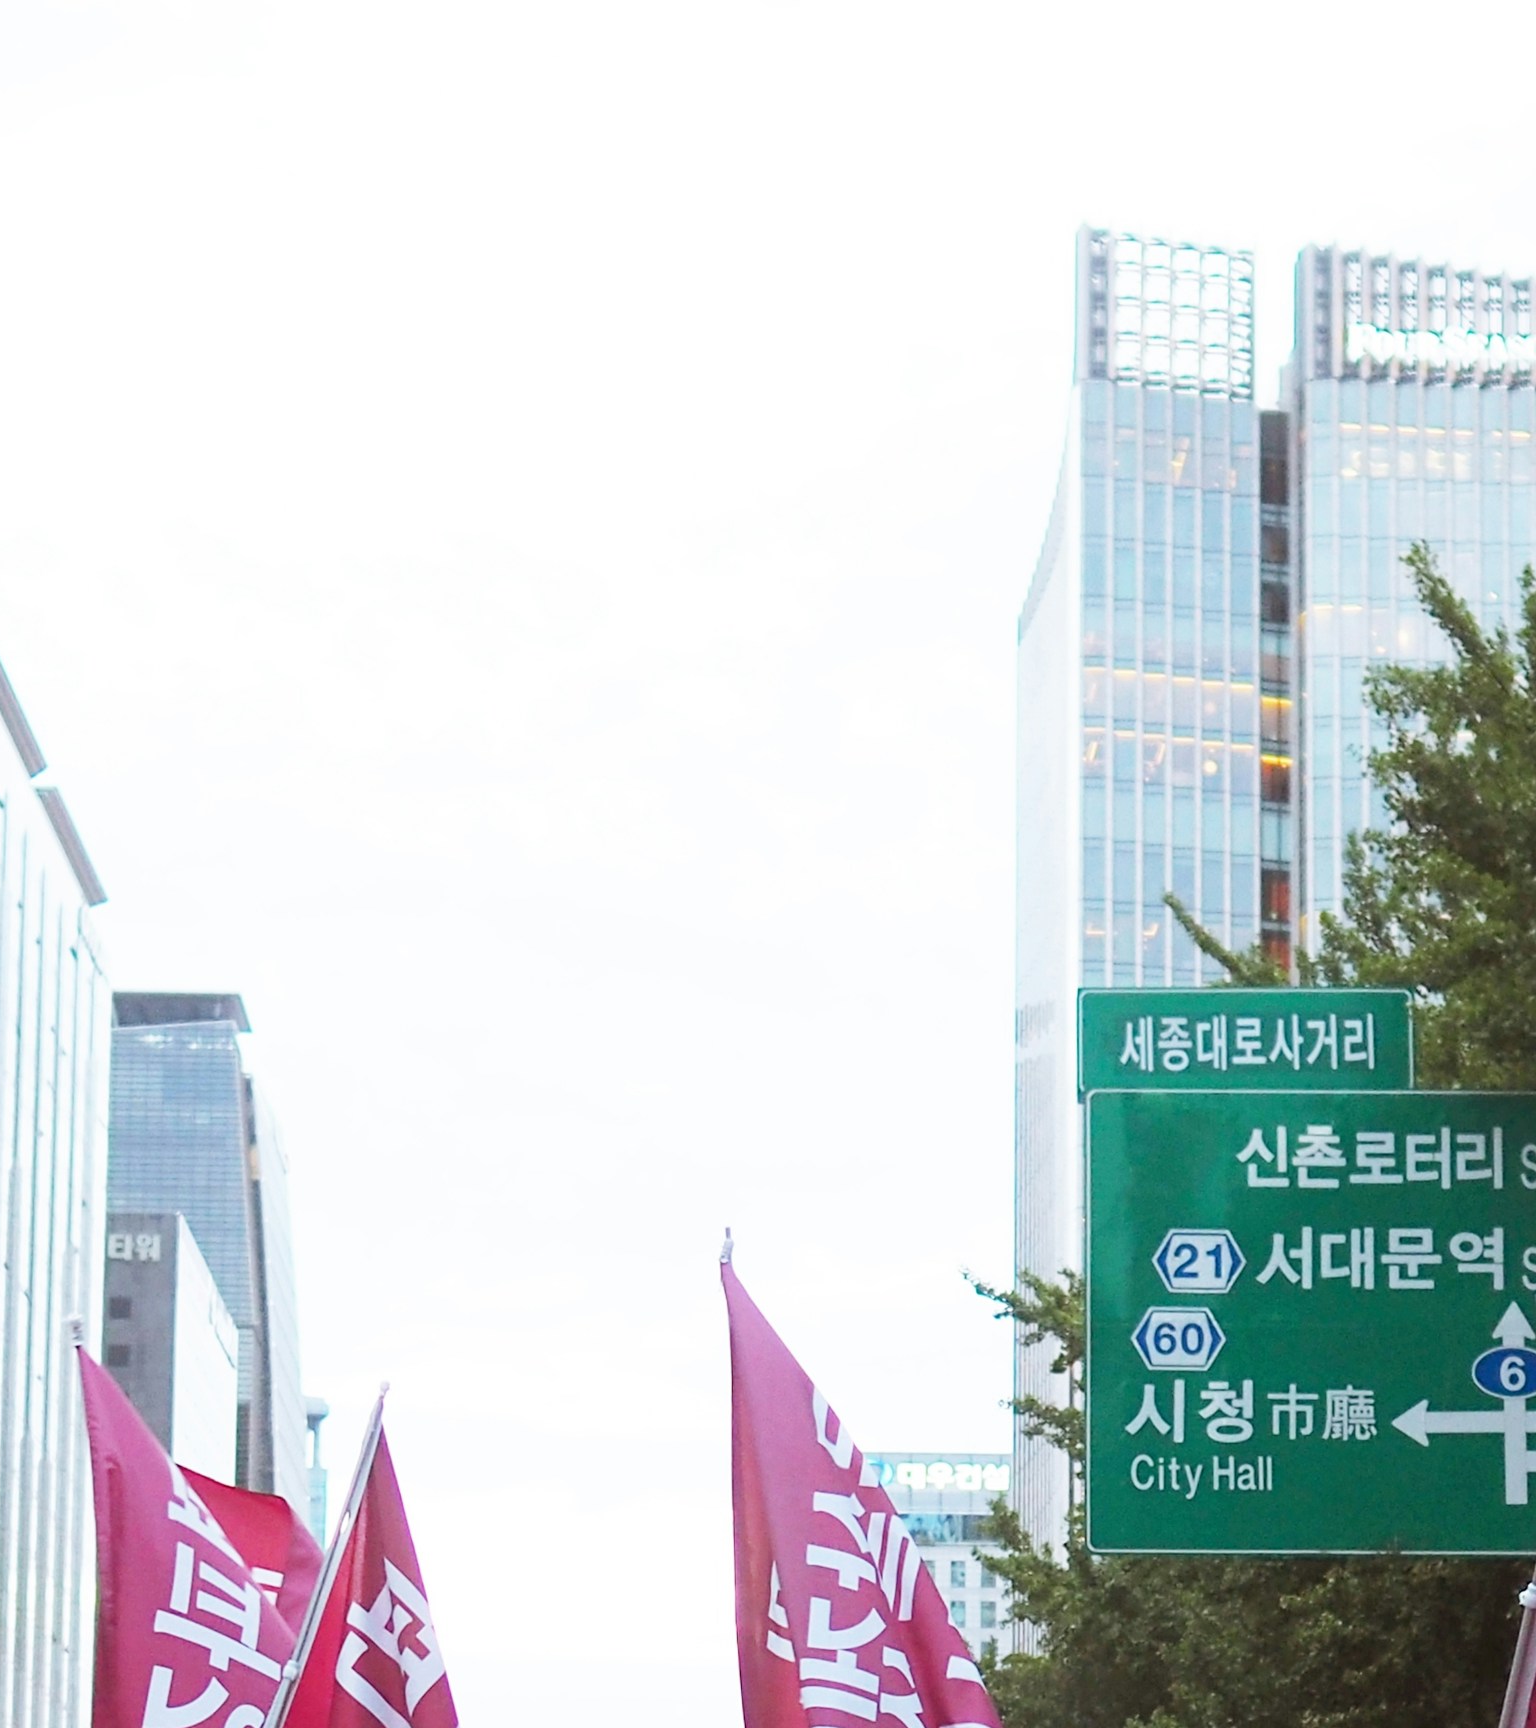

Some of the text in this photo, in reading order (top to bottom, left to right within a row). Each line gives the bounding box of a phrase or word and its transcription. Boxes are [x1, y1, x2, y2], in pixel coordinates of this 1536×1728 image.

[1120, 1013, 1375, 1072] 세종대로사거리
[1237, 1126, 1503, 1189] 신촌로터리
[107, 1234, 161, 1262] 타워
[1173, 1243, 1225, 1279] 21
[1256, 1226, 1505, 1291] 서대문역
[1153, 1323, 1204, 1355] 60
[1499, 1356, 1526, 1391] 6
[1125, 1379, 1377, 1443] 시청 市廳
[896, 1461, 1010, 1491] 대우건설
[1130, 1455, 1273, 1499] City Hall
